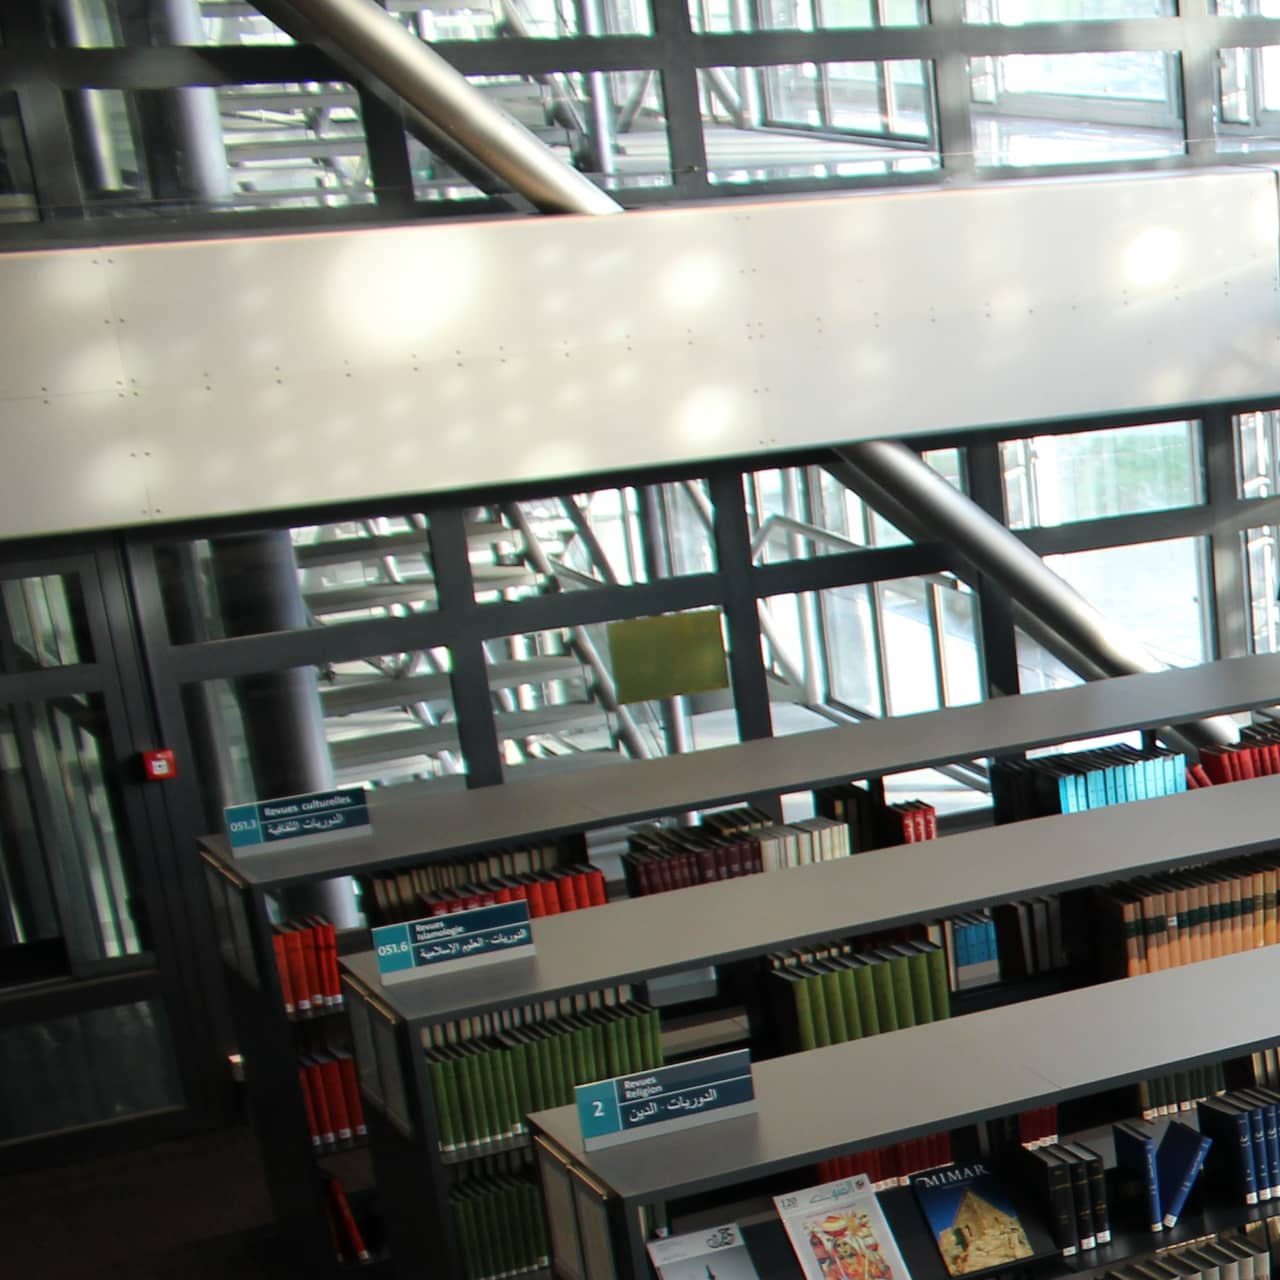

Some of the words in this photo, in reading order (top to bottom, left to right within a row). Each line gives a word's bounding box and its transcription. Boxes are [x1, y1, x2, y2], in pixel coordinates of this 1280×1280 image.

[264, 804, 298, 817] Revues
[301, 795, 352, 811] culturelles
[415, 921, 445, 931] Revues
[377, 942, 408, 957] 051.6
[623, 1076, 657, 1089] Revues
[625, 1084, 663, 1099] Religion
[666, 1088, 717, 1110] الدوريات
[592, 1101, 605, 1117] 2
[628, 1102, 658, 1122] الدين
[915, 1164, 990, 1188] MIMAR
